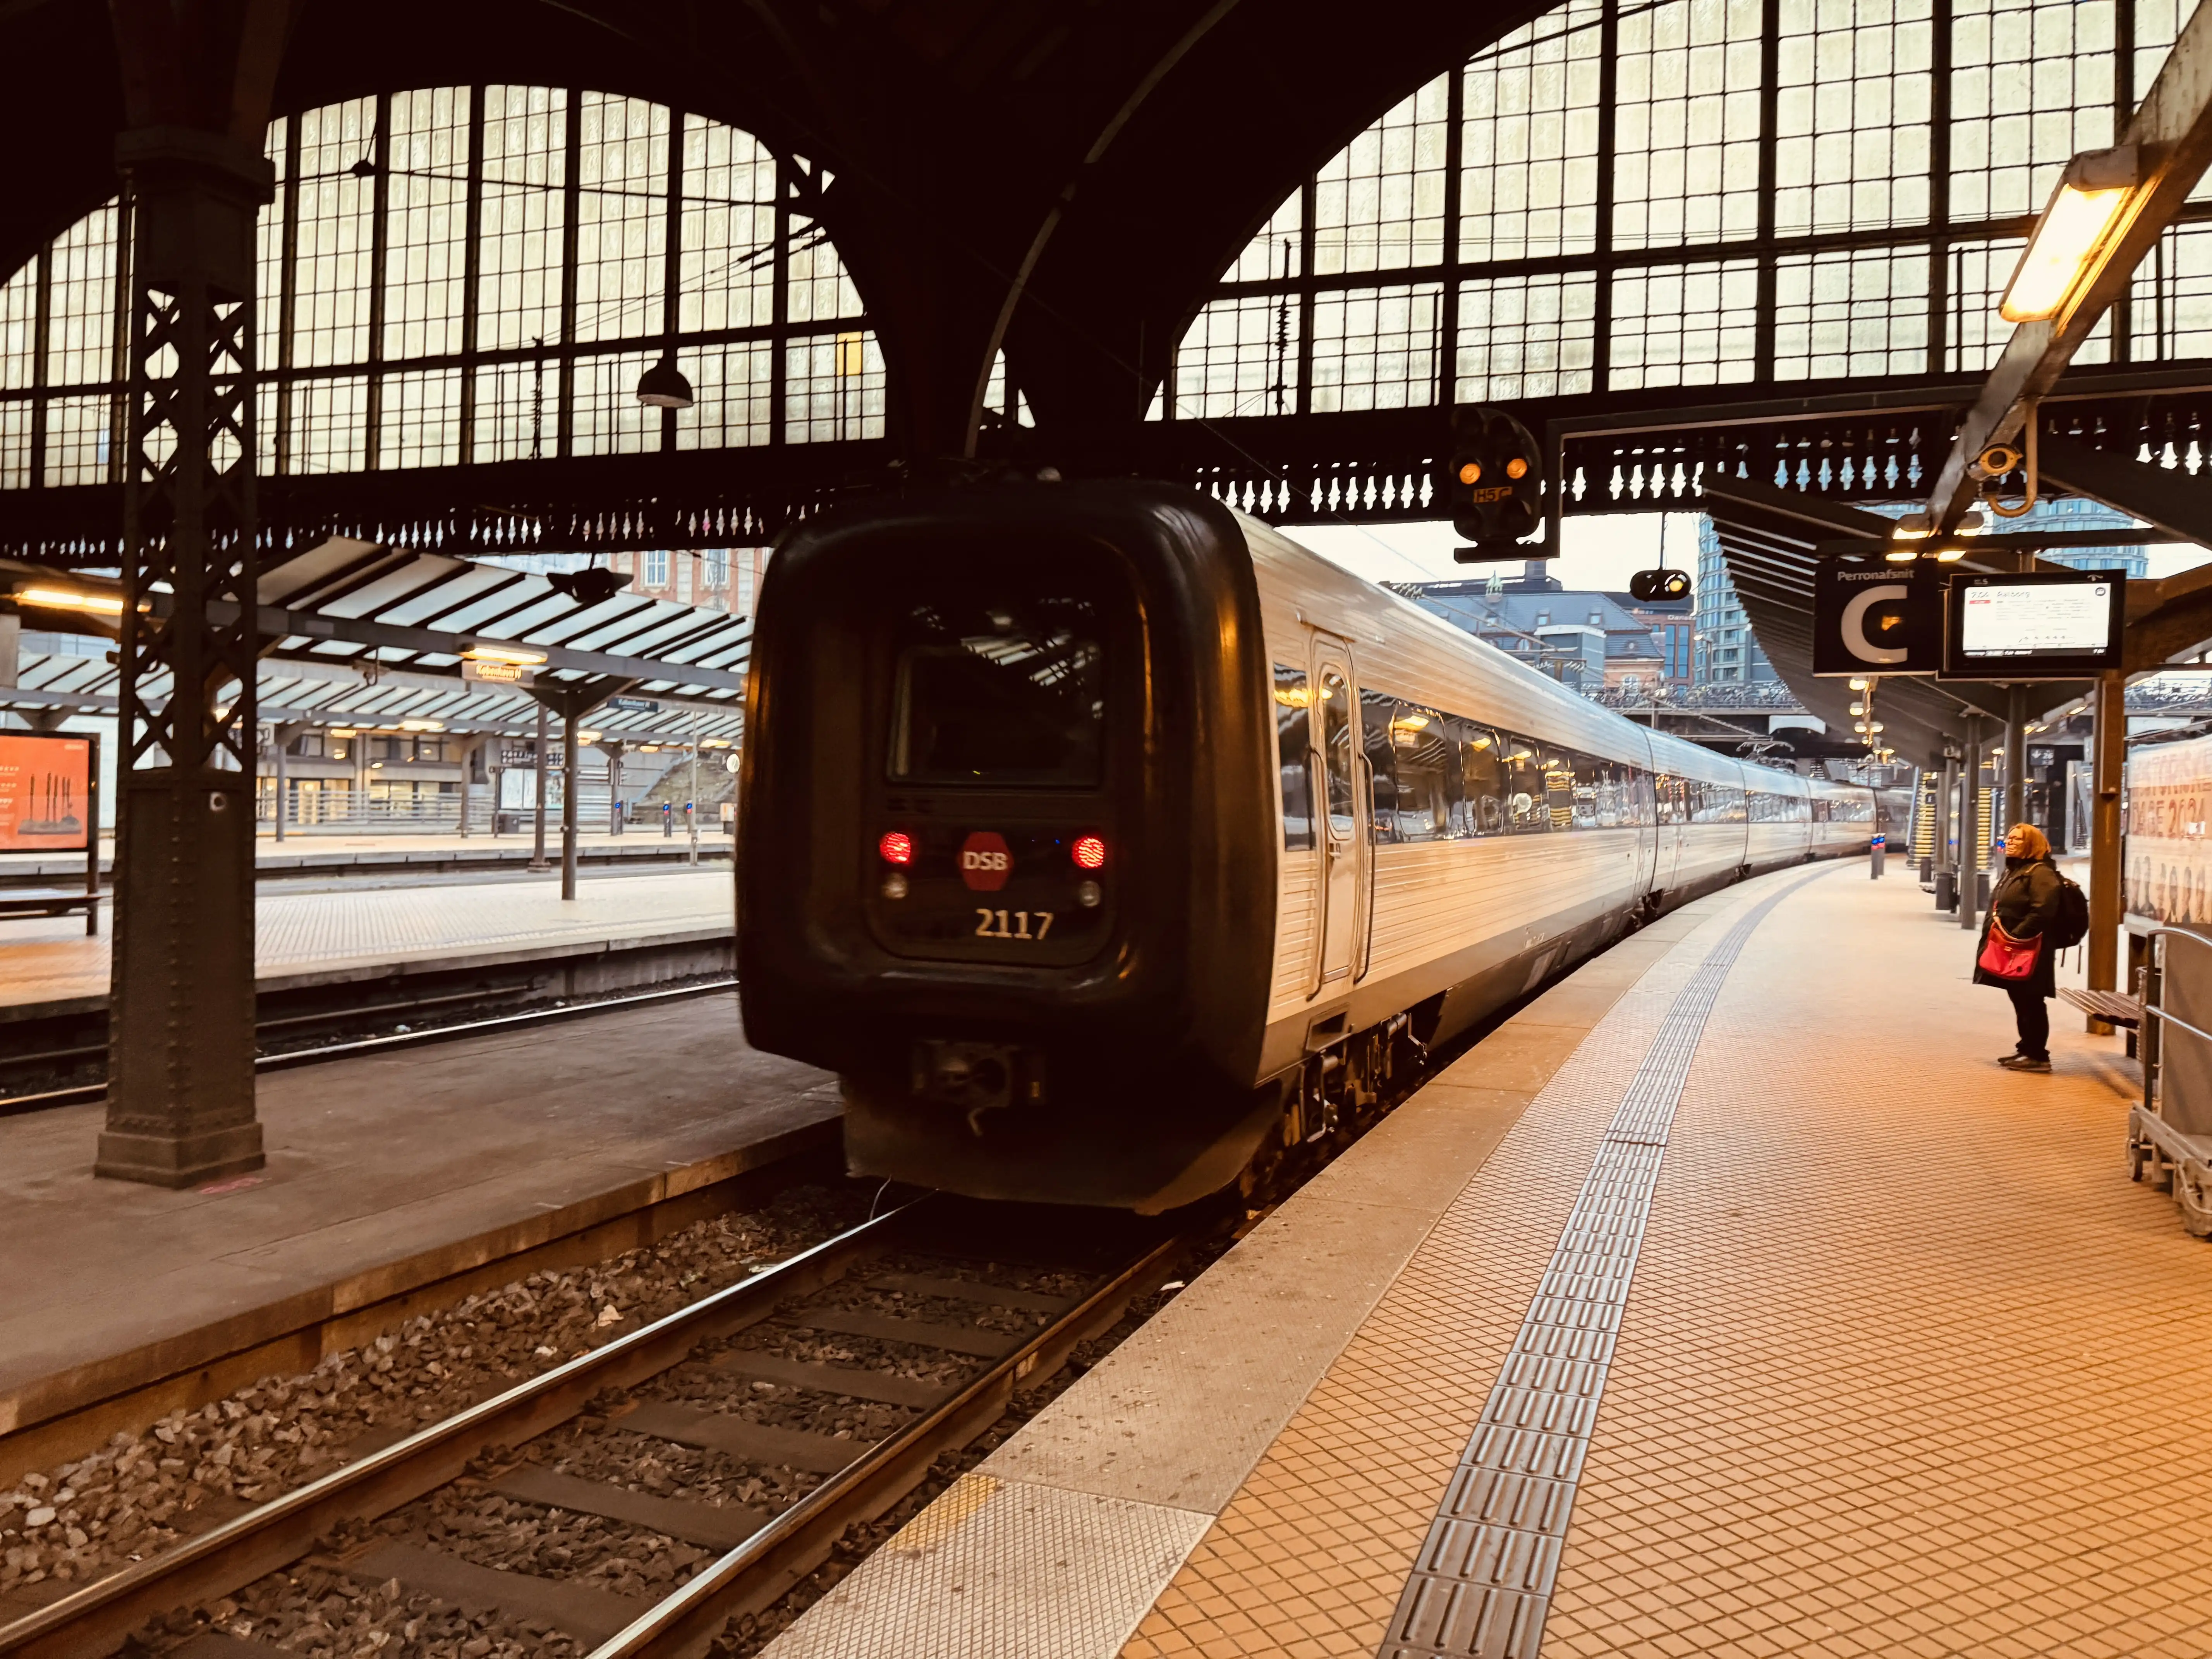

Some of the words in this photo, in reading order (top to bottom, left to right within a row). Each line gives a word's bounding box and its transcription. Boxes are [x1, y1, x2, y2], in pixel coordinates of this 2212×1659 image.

[1838, 569, 1915, 581] Perronafsnit
[1841, 585, 1908, 664] C
[963, 851, 1008, 870] DSB
[975, 908, 1054, 939] 2117
